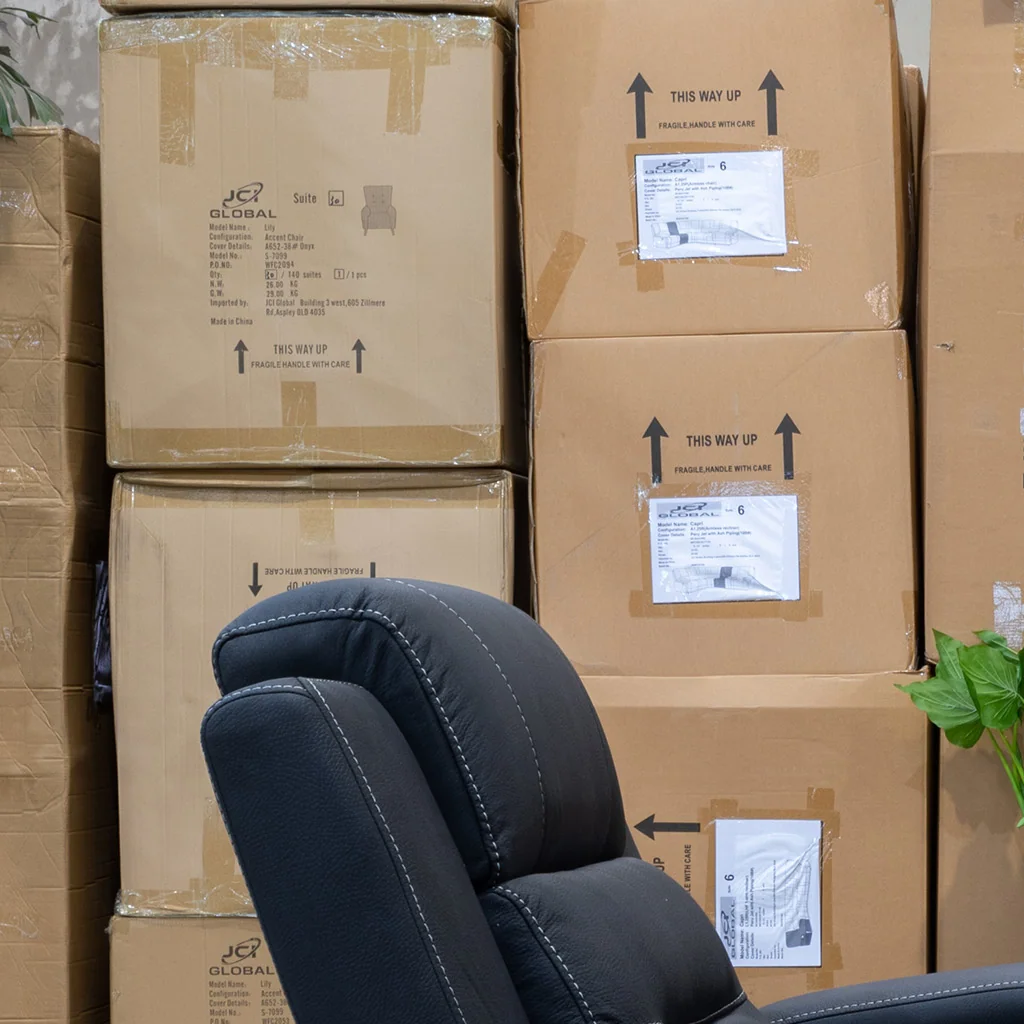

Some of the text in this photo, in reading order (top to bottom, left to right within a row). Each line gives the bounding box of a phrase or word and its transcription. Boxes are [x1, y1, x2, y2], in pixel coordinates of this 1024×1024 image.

[670, 90, 742, 103] THIS WAY UP
[658, 121, 716, 130] FRAGILE,HANDLE
[720, 161, 727, 171] 6
[293, 192, 317, 204] Suite
[210, 209, 277, 218] GLOBAL
[264, 224, 276, 232] Lily
[264, 234, 304, 242] Accent Chair
[210, 318, 227, 326] Made
[236, 318, 254, 326] China
[274, 344, 328, 354] THIS WAY UP
[686, 434, 758, 448] THIS WAY UP
[674, 466, 732, 474] FRAGILE,HANDLE
[753, 464, 772, 472] CARE
[737, 505, 745, 516] 6
[264, 568, 364, 576] FRAGILE HANDLE WITH CARE
[684, 844, 692, 882] WITH CARE
[724, 874, 734, 882] 6
[208, 966, 276, 976] GLOBAL
[260, 980, 272, 988] Lily
